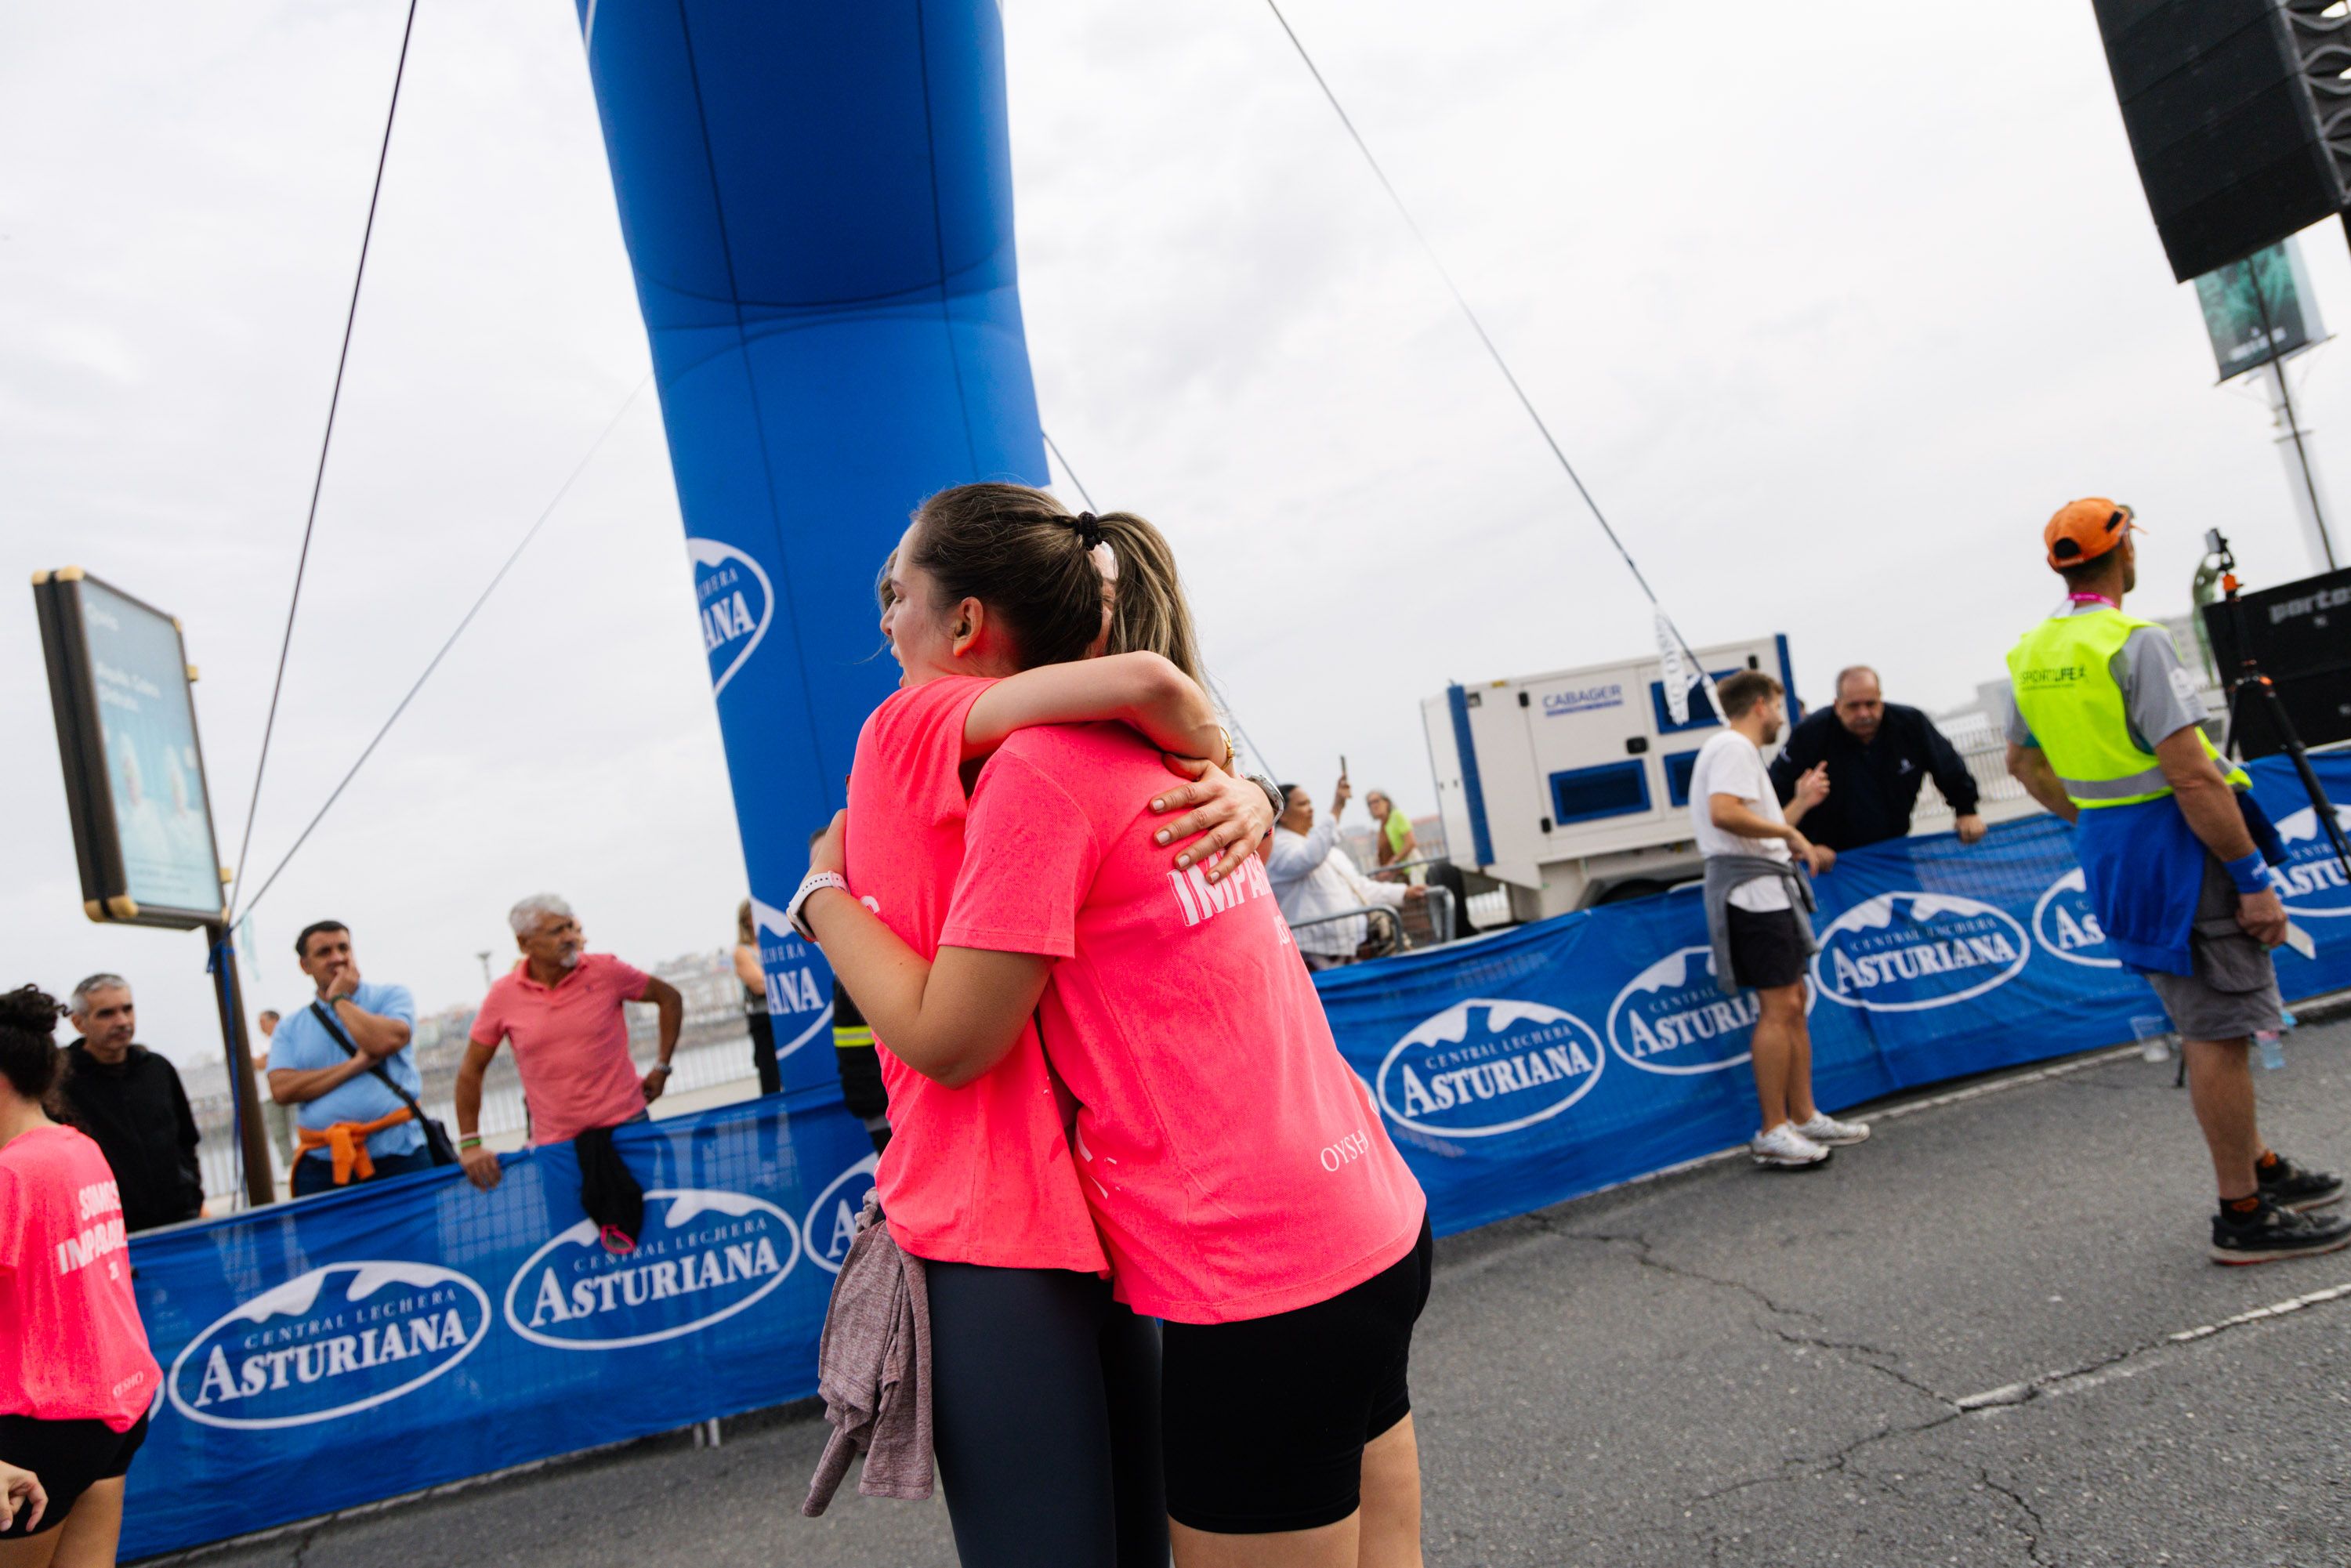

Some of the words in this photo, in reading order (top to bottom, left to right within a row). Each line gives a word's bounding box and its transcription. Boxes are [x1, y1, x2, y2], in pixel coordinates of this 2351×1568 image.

[1542, 683, 1622, 708] CABAGER
[1832, 932, 2020, 994] ASTURIANA
[1425, 1042, 1498, 1070] CENTRAL
[1502, 1024, 1573, 1053] LECHERA
[1403, 1040, 1594, 1118] ASTURIANA
[675, 1217, 768, 1251] LECHERA
[528, 1236, 782, 1329] ASTURIANA
[244, 1313, 346, 1350] CENTRAL
[356, 1287, 458, 1324] LECHERA
[193, 1307, 468, 1409] ASTURIANA
